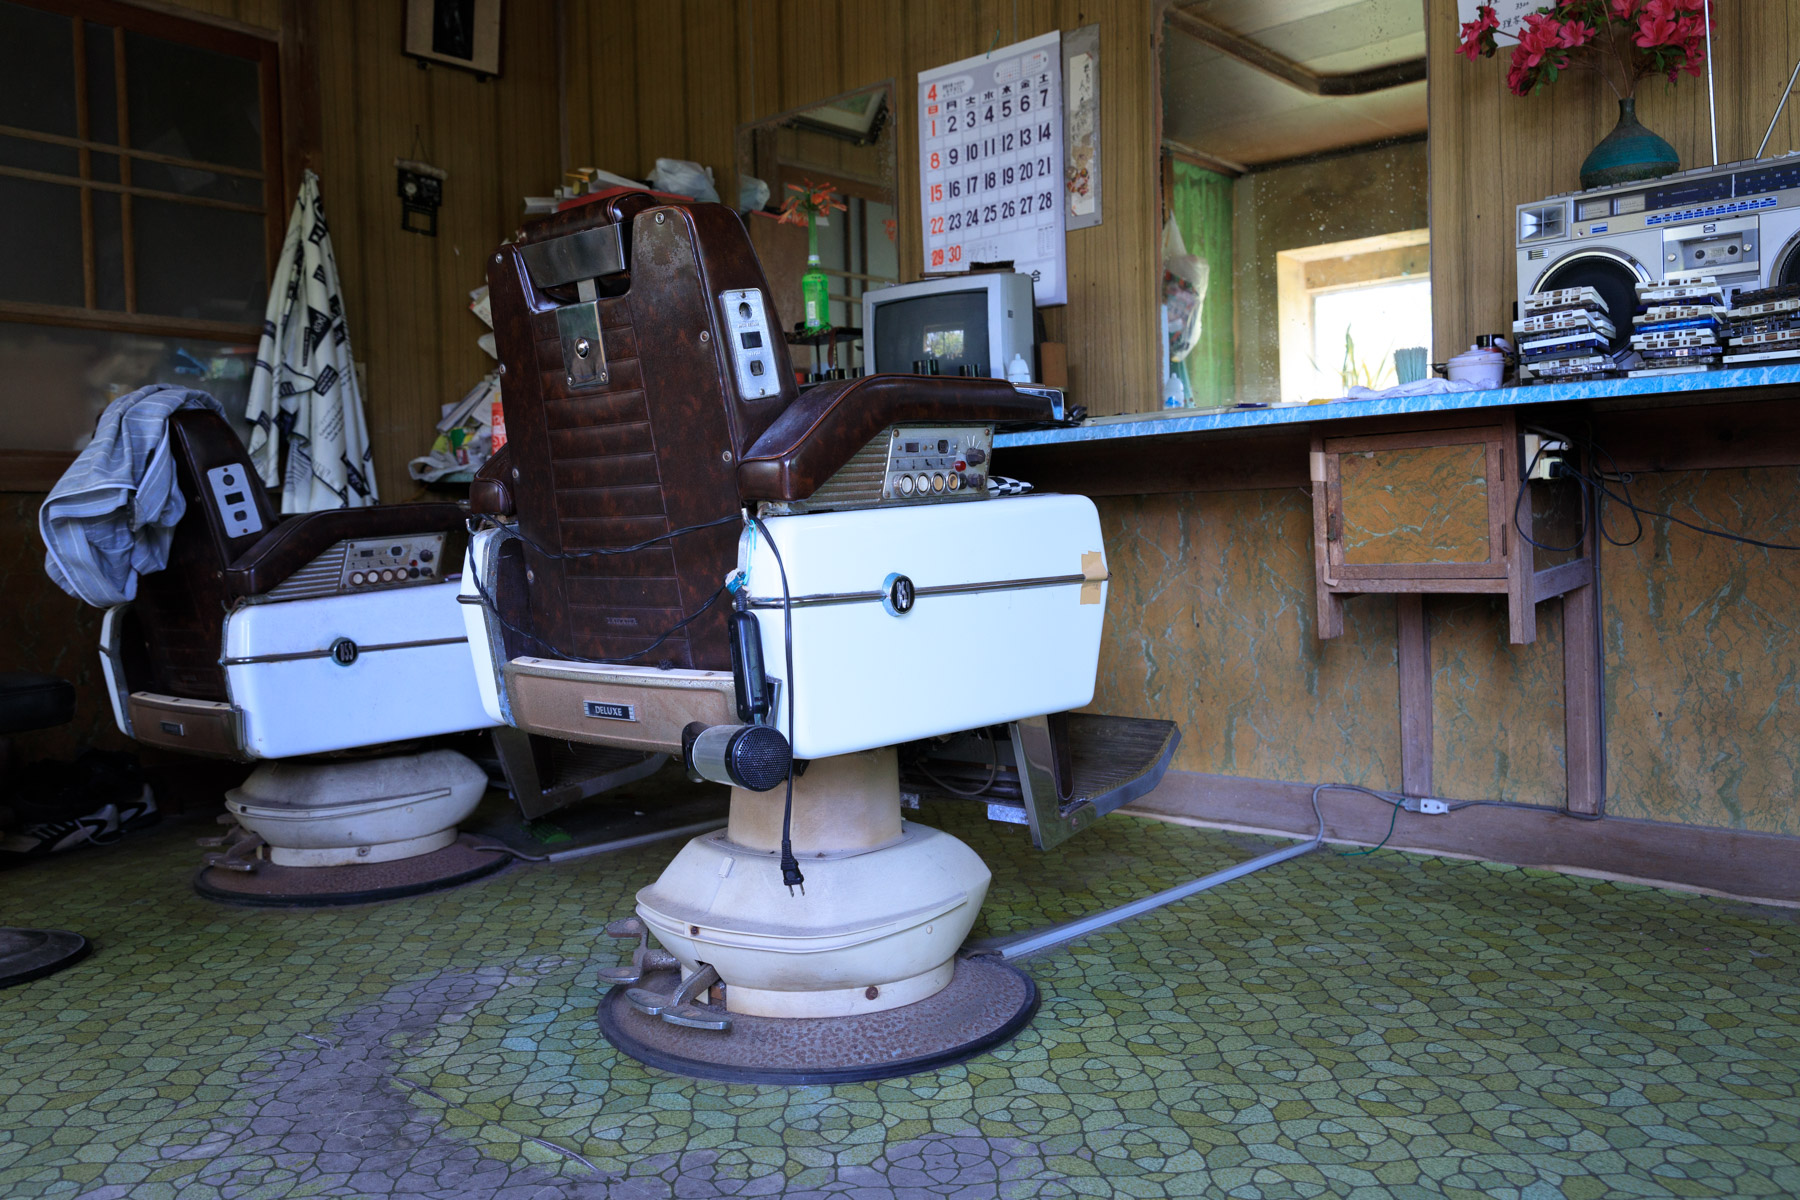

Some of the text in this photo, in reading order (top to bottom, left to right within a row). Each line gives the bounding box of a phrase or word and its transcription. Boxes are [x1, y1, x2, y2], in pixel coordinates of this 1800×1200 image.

[927, 84, 937, 101] 4
[927, 74, 1048, 114] 日 月 火 水 木 金 土
[947, 116, 957, 133] 2
[966, 111, 975, 128] 3
[984, 106, 994, 122] 4
[1002, 100, 1011, 117] 5
[1020, 95, 1030, 112] 6
[1039, 88, 1048, 107] 7
[930, 153, 940, 169] 8
[948, 149, 958, 165] 9
[966, 144, 978, 161] 10
[984, 138, 995, 156] 11
[1002, 133, 1013, 152] 12
[1019, 128, 1031, 147] 13
[1038, 123, 1051, 141] 14
[930, 157, 1050, 202] 15 16 17 18 19 20 21
[930, 192, 1052, 234] 22 23 24 25 26 27 28
[931, 249, 944, 266] 29
[948, 245, 961, 262] 30
[594, 705, 623, 717] DELUXE
